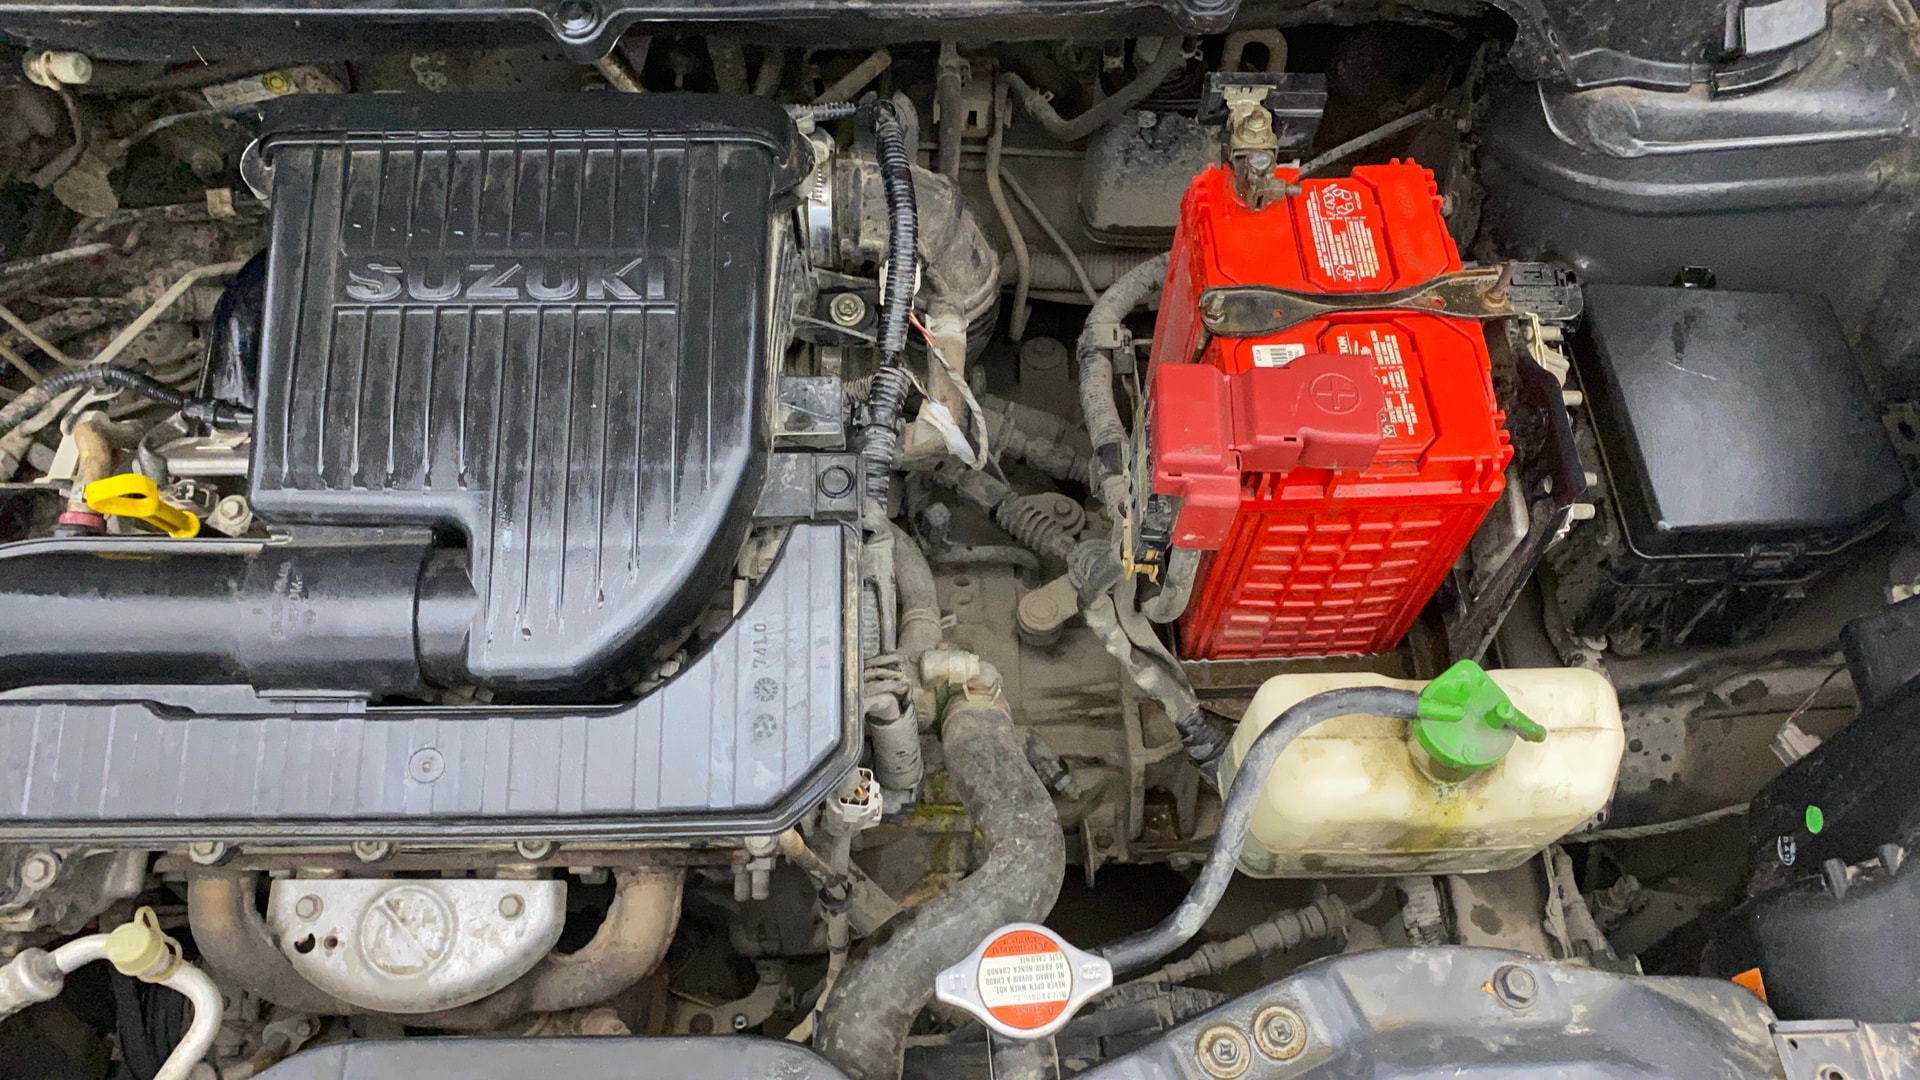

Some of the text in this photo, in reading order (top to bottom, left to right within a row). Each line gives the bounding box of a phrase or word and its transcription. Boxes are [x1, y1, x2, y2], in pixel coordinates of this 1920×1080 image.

[346, 256, 666, 301] SUZUKI
[1049, 952, 1062, 960] ESTE
[987, 967, 1010, 975] CUANDO
[1014, 965, 1032, 973] NUNCA
[1013, 974, 1032, 982] OUVRIR
[1035, 972, 1054, 980] JAMAIS
[1010, 984, 1026, 992] WHEN
[1030, 982, 1044, 990] OPEN
